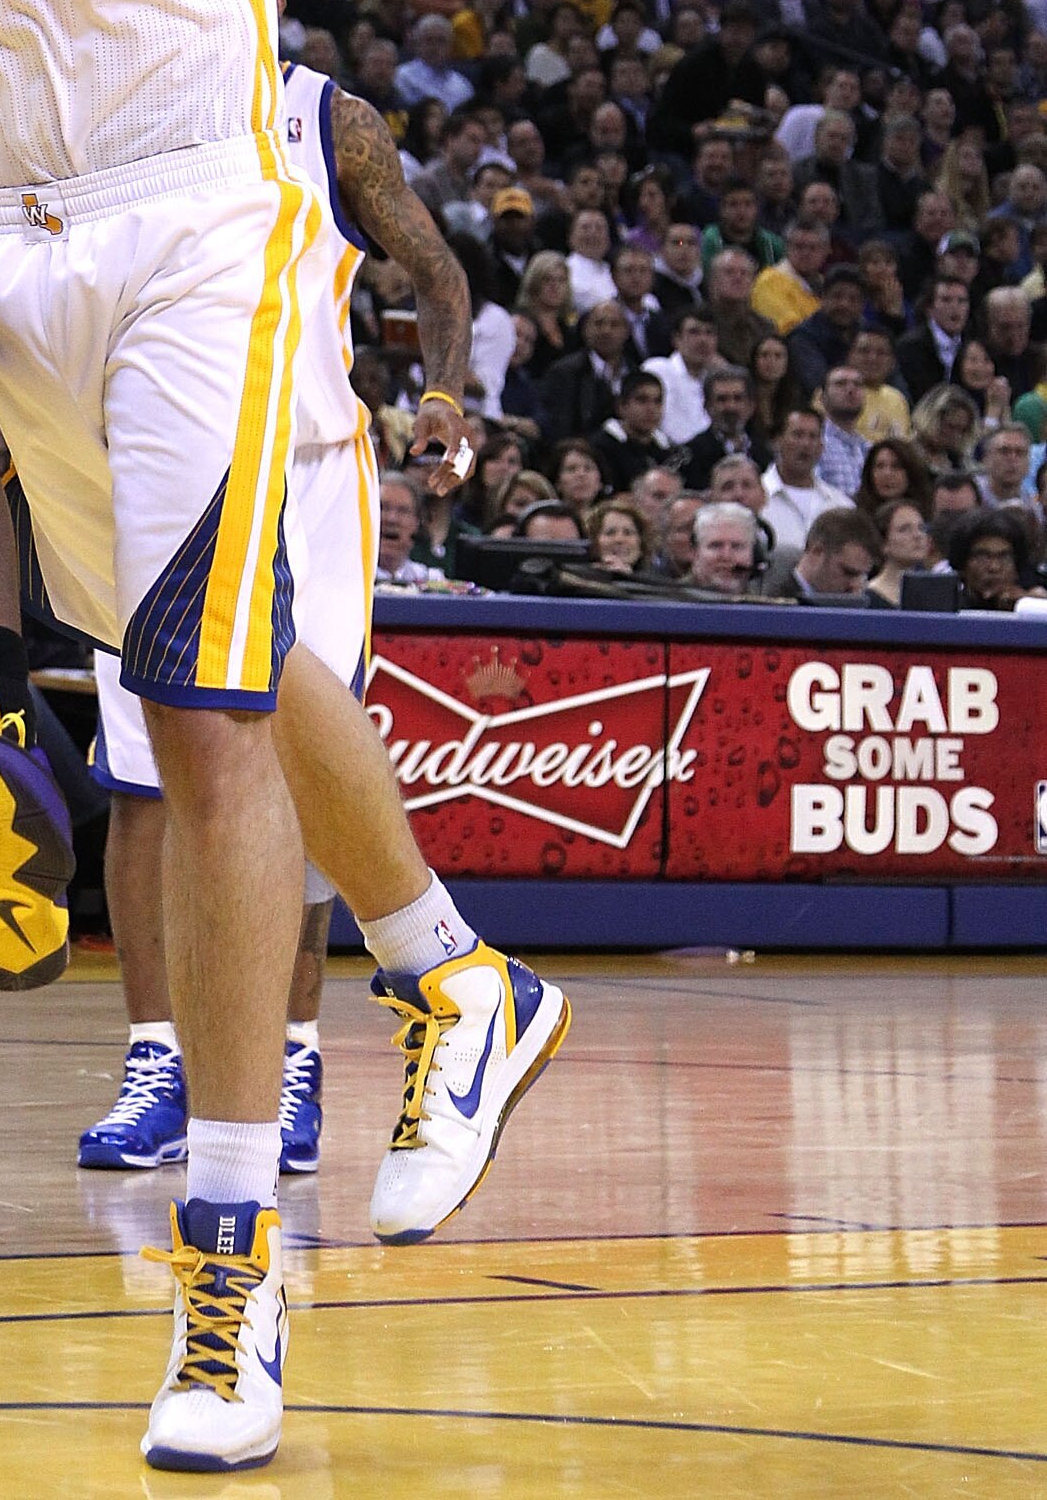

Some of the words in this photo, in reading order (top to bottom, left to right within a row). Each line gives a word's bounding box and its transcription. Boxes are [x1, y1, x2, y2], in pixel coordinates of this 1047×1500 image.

[787, 661, 999, 734] GRAB
[823, 734, 965, 781] SOME
[791, 783, 999, 855] BUDS
